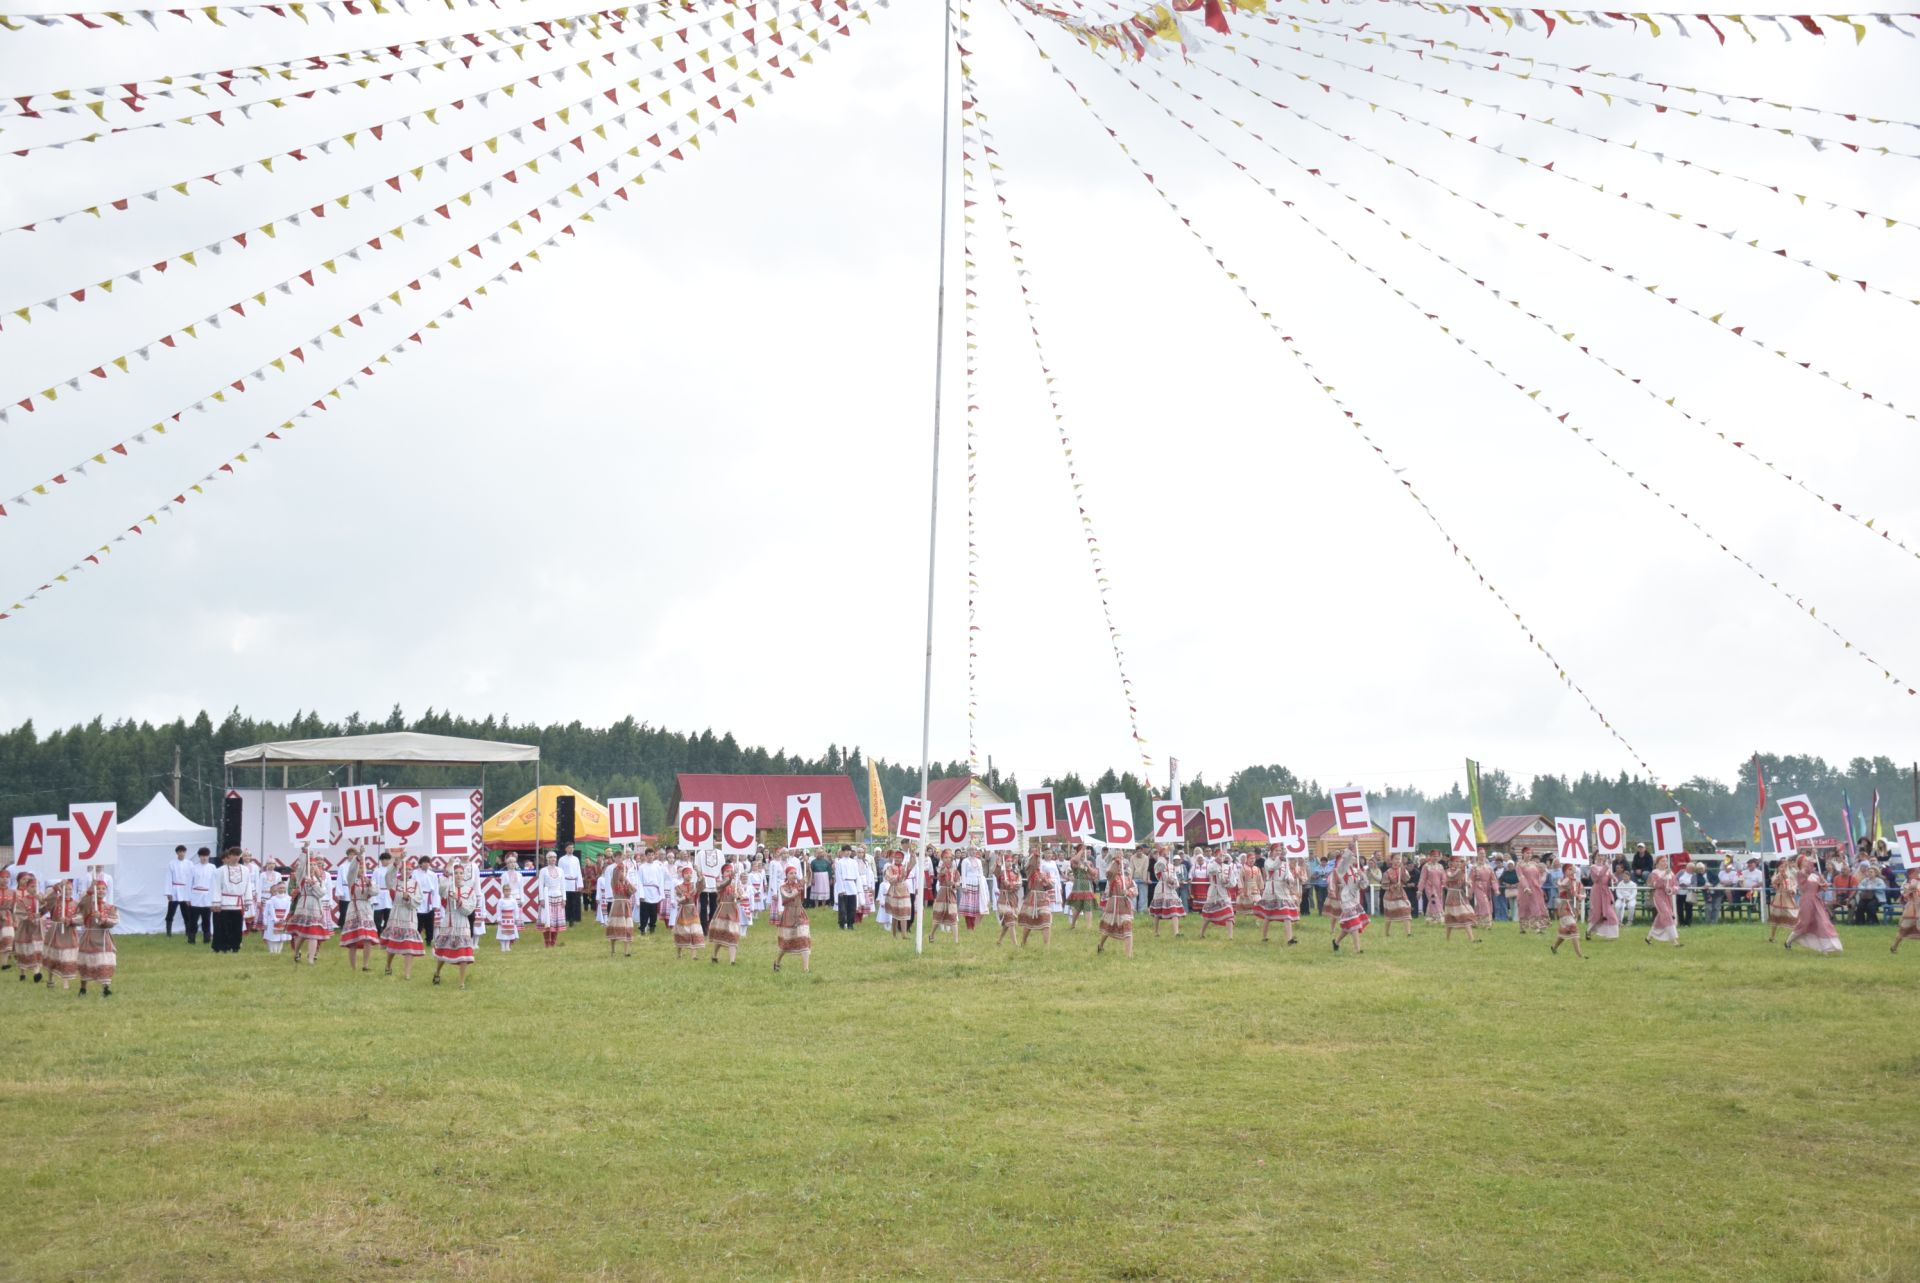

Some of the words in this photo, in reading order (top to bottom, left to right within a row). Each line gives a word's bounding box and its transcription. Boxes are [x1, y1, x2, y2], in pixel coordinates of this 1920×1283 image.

[289, 799, 321, 839] У
[341, 789, 379, 832] Щ
[608, 802, 640, 839] Ш
[680, 807, 712, 848] Ф
[723, 808, 754, 849] С
[940, 809, 968, 844] Ю
[984, 808, 1016, 845] Б
[1023, 792, 1055, 832] Л
[1068, 800, 1093, 832] И
[1104, 804, 1133, 844] Ь
[1156, 804, 1184, 837] Я
[1205, 805, 1233, 840] Ы
[1265, 800, 1297, 837] М
[1335, 791, 1368, 830] Е
[1781, 800, 1818, 835] В
[17, 822, 43, 865] А
[72, 810, 113, 860] У
[435, 812, 468, 855] Е
[1286, 824, 1306, 853] З
[1391, 815, 1416, 849] П
[1450, 818, 1476, 852] Х
[1557, 822, 1588, 860] Ж
[1599, 818, 1621, 850] О
[1655, 816, 1676, 850] Г
[1772, 821, 1796, 853] Н
